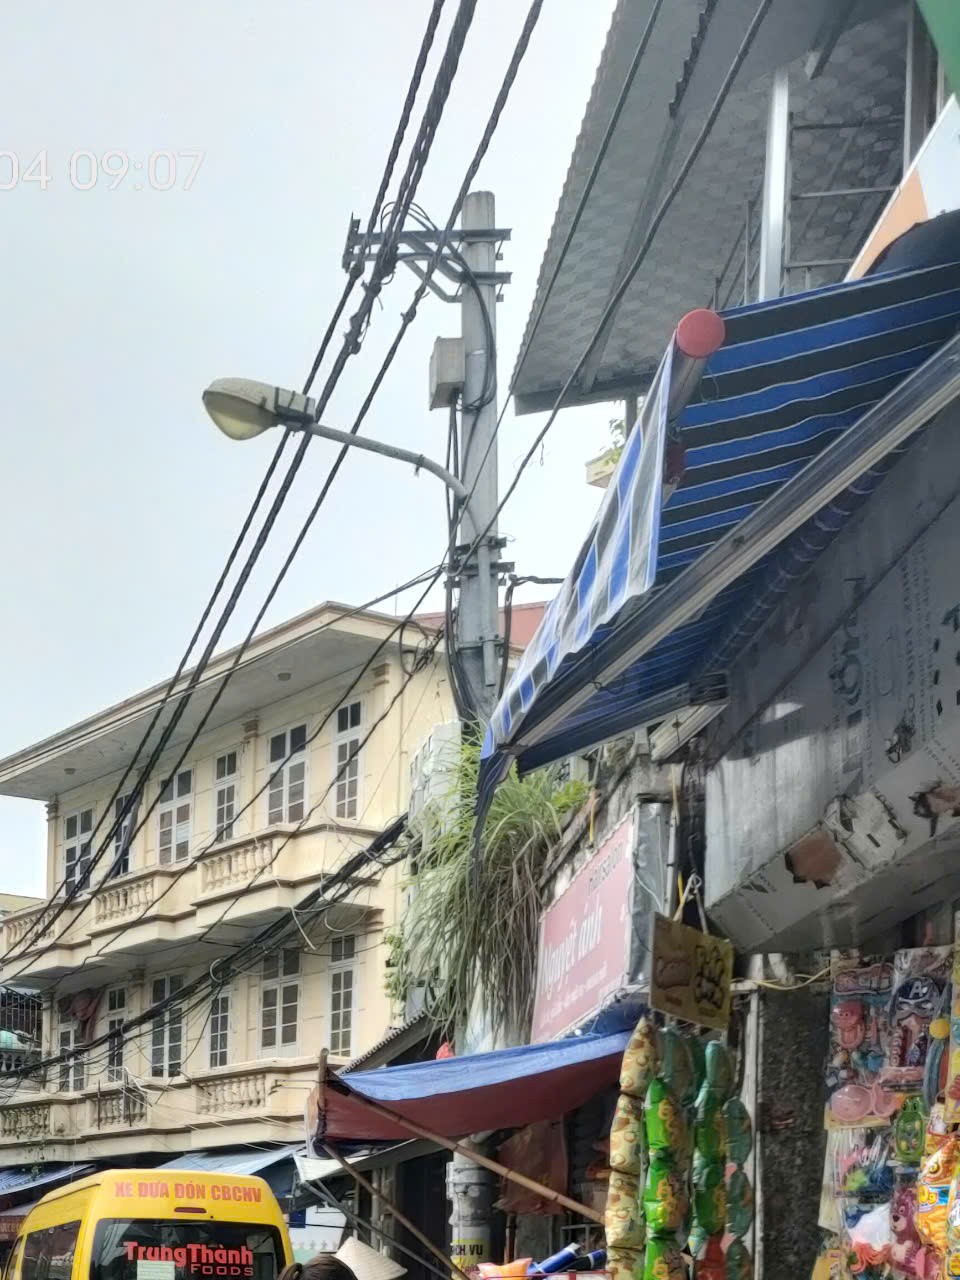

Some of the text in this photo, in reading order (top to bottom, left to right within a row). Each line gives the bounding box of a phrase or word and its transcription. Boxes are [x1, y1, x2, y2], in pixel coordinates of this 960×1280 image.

[115, 1182, 133, 1198] XE
[175, 1181, 206, 1199] ĐÓN
[210, 1184, 262, 1203] CBCNV
[191, 1263, 254, 1276] FOODS
